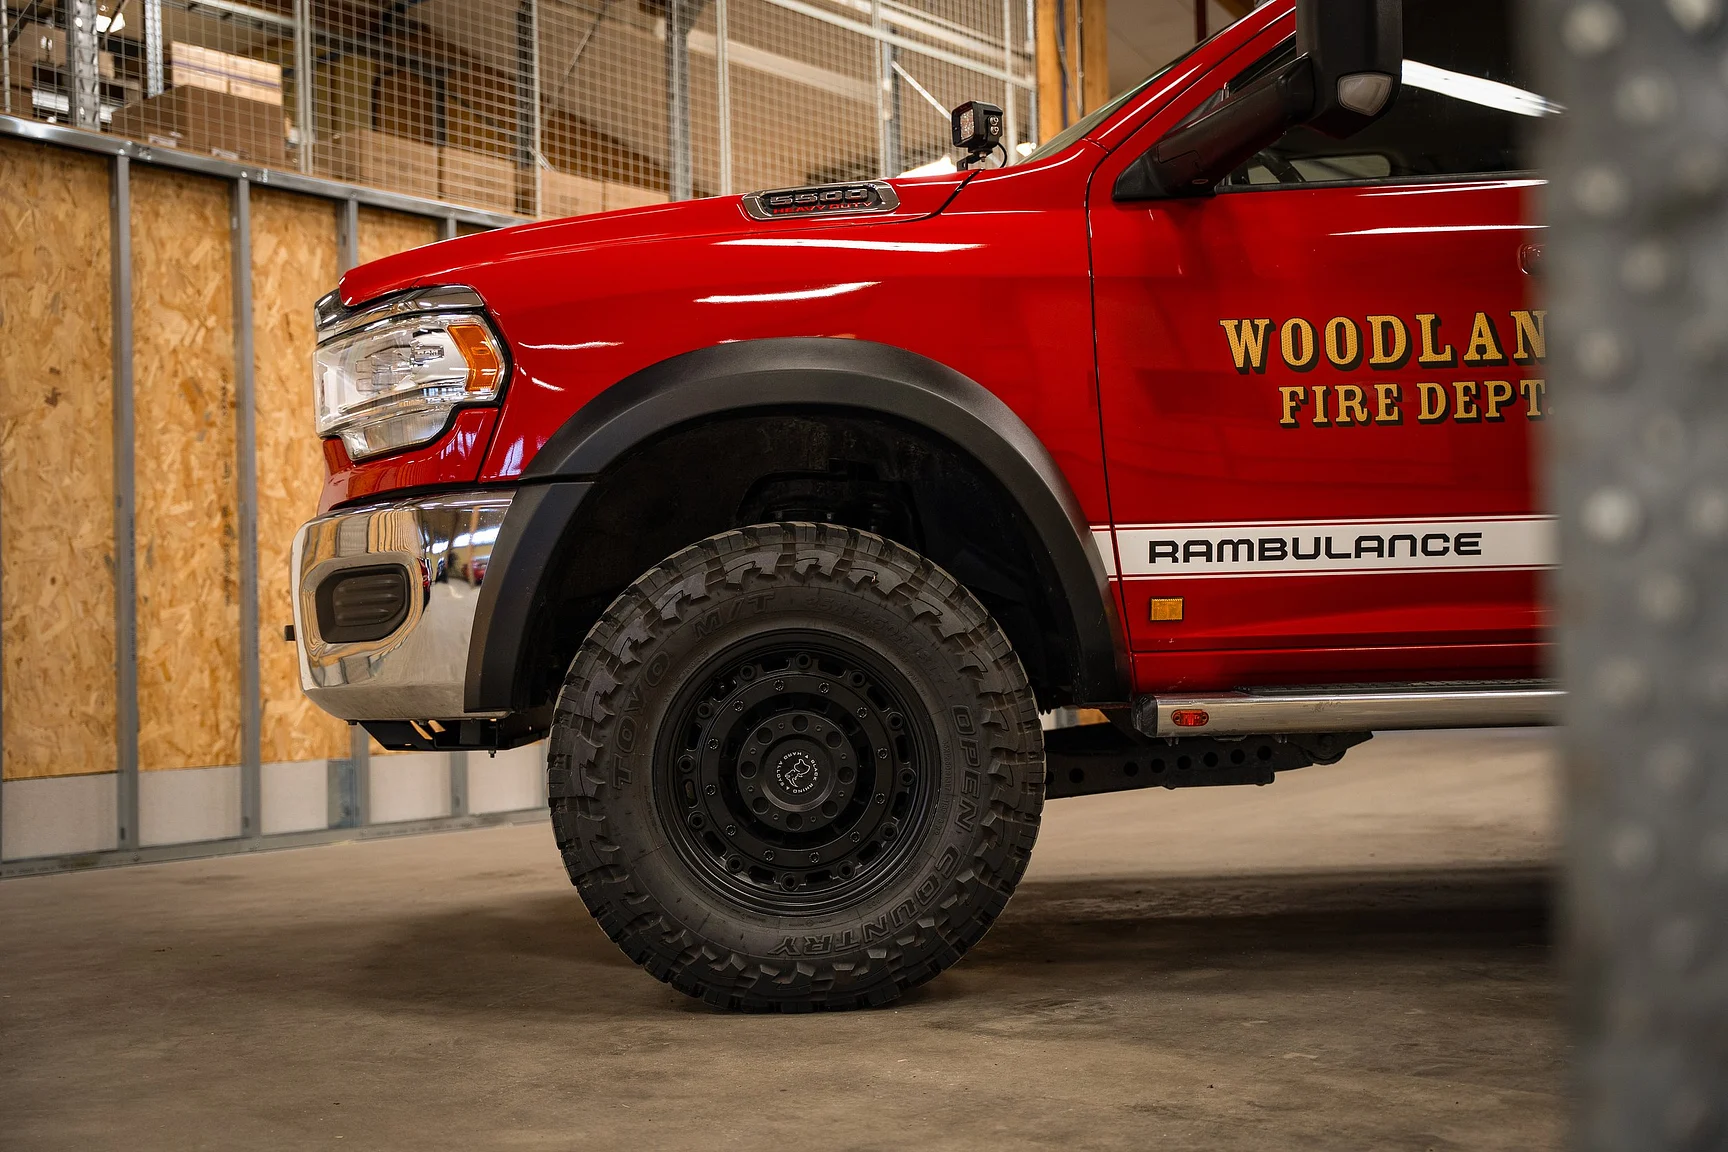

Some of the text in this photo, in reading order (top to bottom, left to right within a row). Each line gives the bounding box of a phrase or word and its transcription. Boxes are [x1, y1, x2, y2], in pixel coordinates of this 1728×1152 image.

[773, 201, 873, 214] HEAVY DUTY
[1278, 383, 1404, 428] FIRE
[1149, 532, 1483, 564] RAMBULANCE
[612, 591, 776, 790] TOYO M/T
[776, 752, 802, 787] HARD ALLOYS
[792, 760, 818, 794] BLACK RHINO
[768, 704, 982, 956] OPEN COUNTRY
